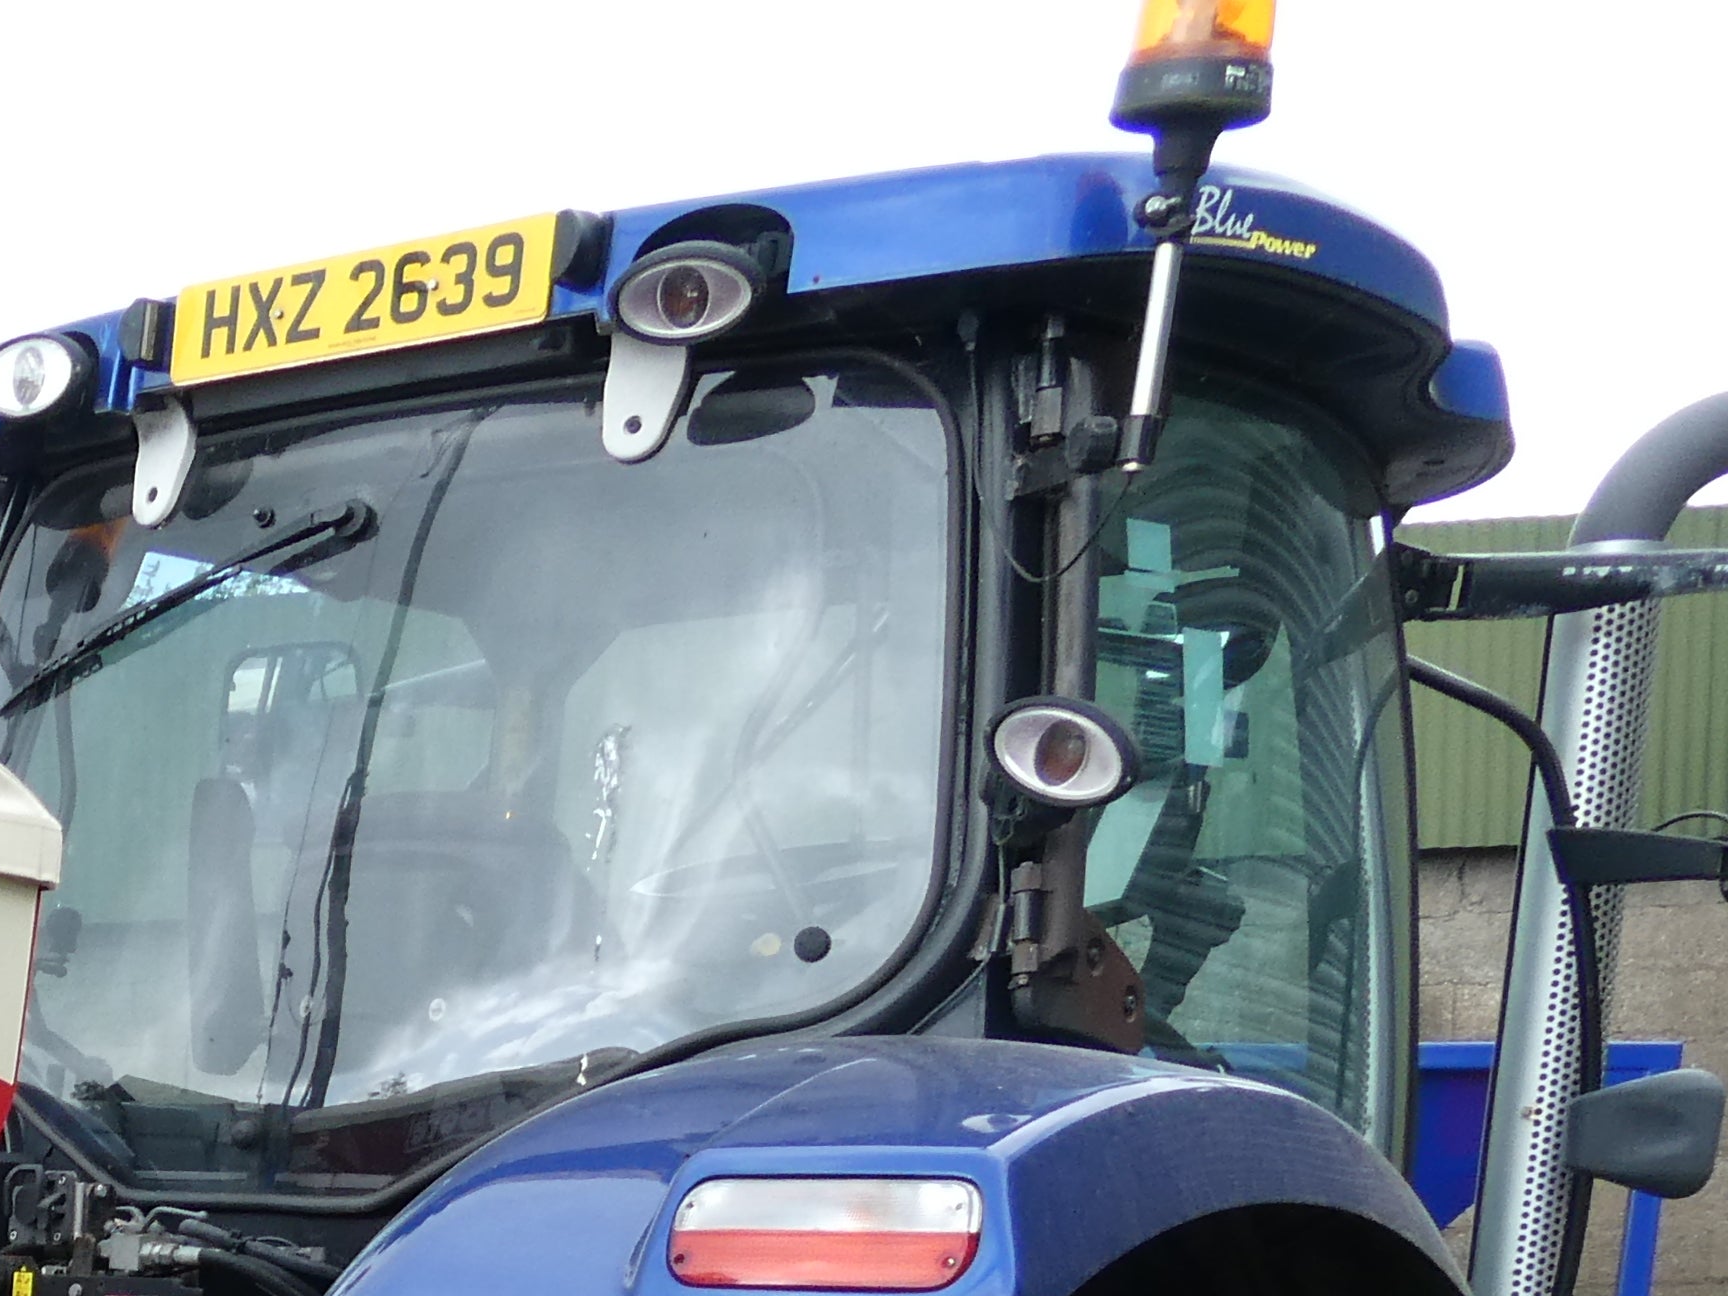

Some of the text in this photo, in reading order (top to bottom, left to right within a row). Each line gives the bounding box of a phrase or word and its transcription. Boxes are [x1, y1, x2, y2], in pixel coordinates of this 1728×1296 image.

[1191, 185, 1254, 239] Blue
[1250, 231, 1316, 259] Power
[200, 232, 524, 359] HXZ 2639
